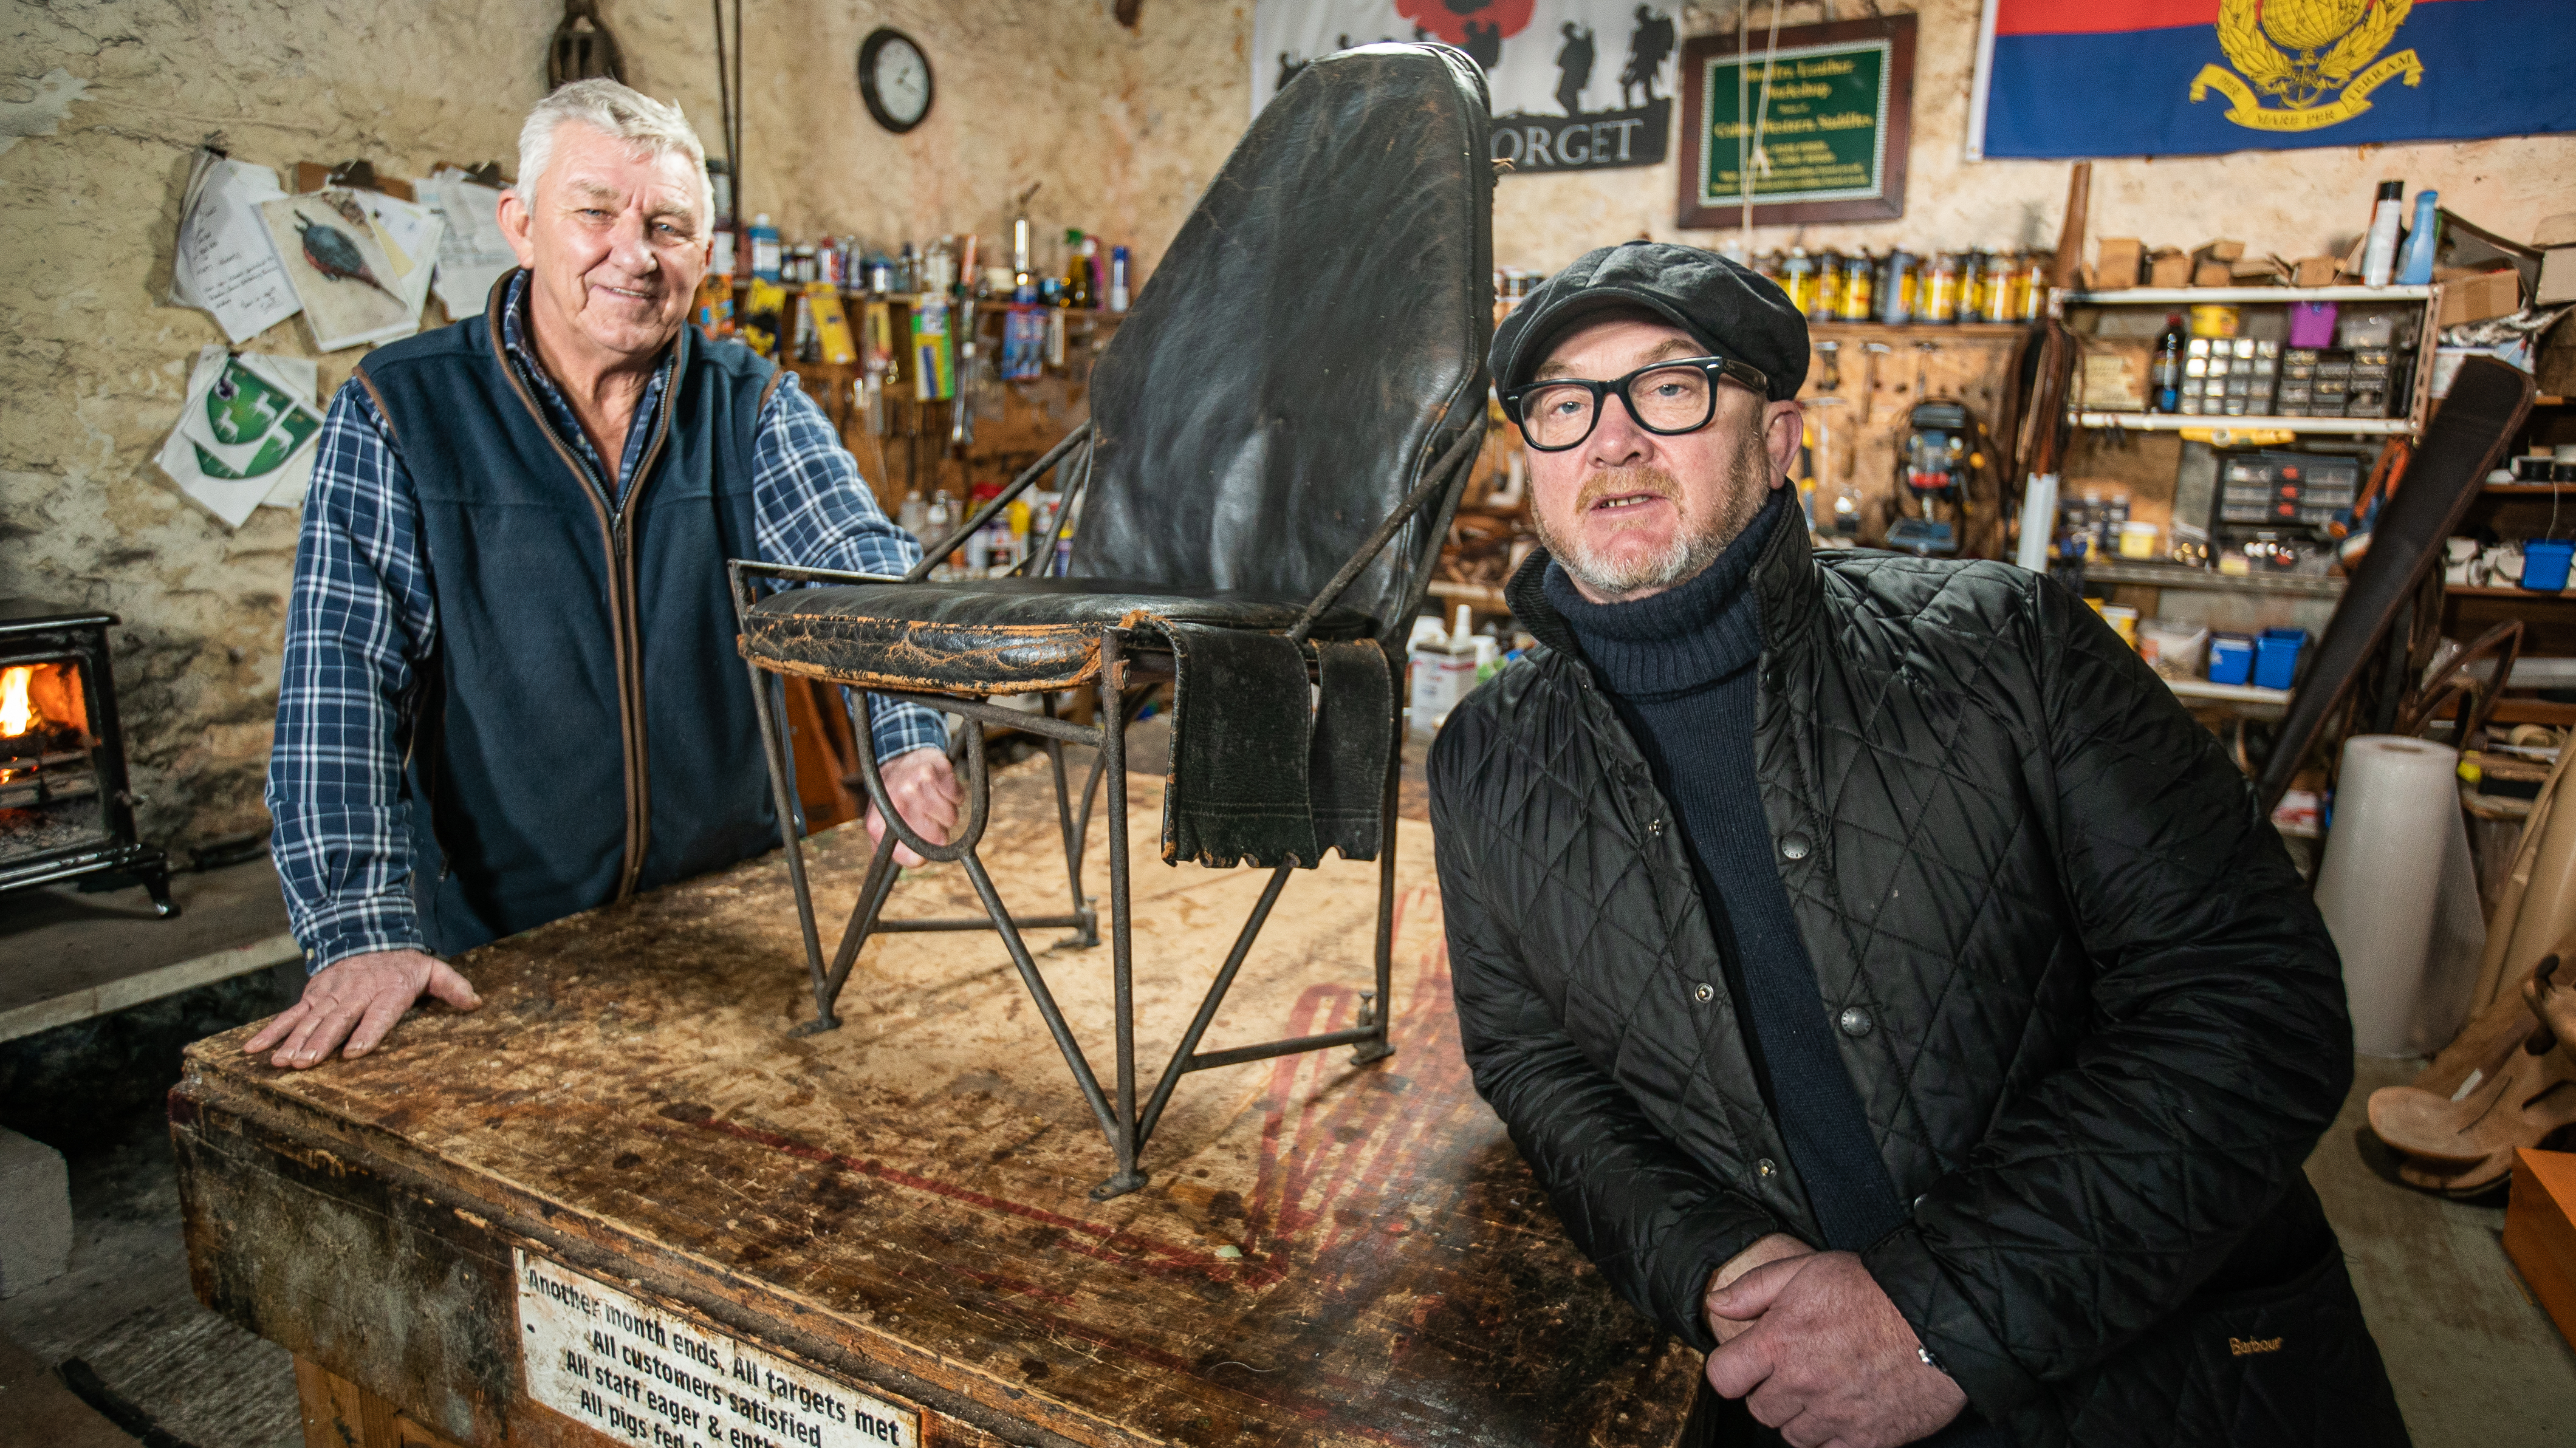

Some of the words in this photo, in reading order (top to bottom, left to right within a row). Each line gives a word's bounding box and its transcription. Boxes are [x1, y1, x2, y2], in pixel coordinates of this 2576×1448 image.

[2256, 113, 2300, 125] MARE
[2306, 109, 2335, 124] PER
[2346, 53, 2412, 100] TERRAM
[529, 1269, 600, 1316] Another
[605, 1303, 666, 1347] month
[673, 1333, 725, 1376] ends,
[733, 1356, 759, 1387] All
[766, 1368, 846, 1422] targets
[855, 1409, 900, 1446] met
[2229, 1336, 2283, 1356] Barbour
[567, 1350, 589, 1379] All
[595, 1367, 640, 1402] staff
[648, 1390, 700, 1429] eager
[708, 1415, 724, 1441] &
[581, 1389, 603, 1418] All
[610, 1406, 648, 1438] pigs
[654, 1422, 685, 1448] fed
[594, 1330, 617, 1359] All
[622, 1344, 722, 1405] customers
[729, 1392, 821, 1448] satisfied
